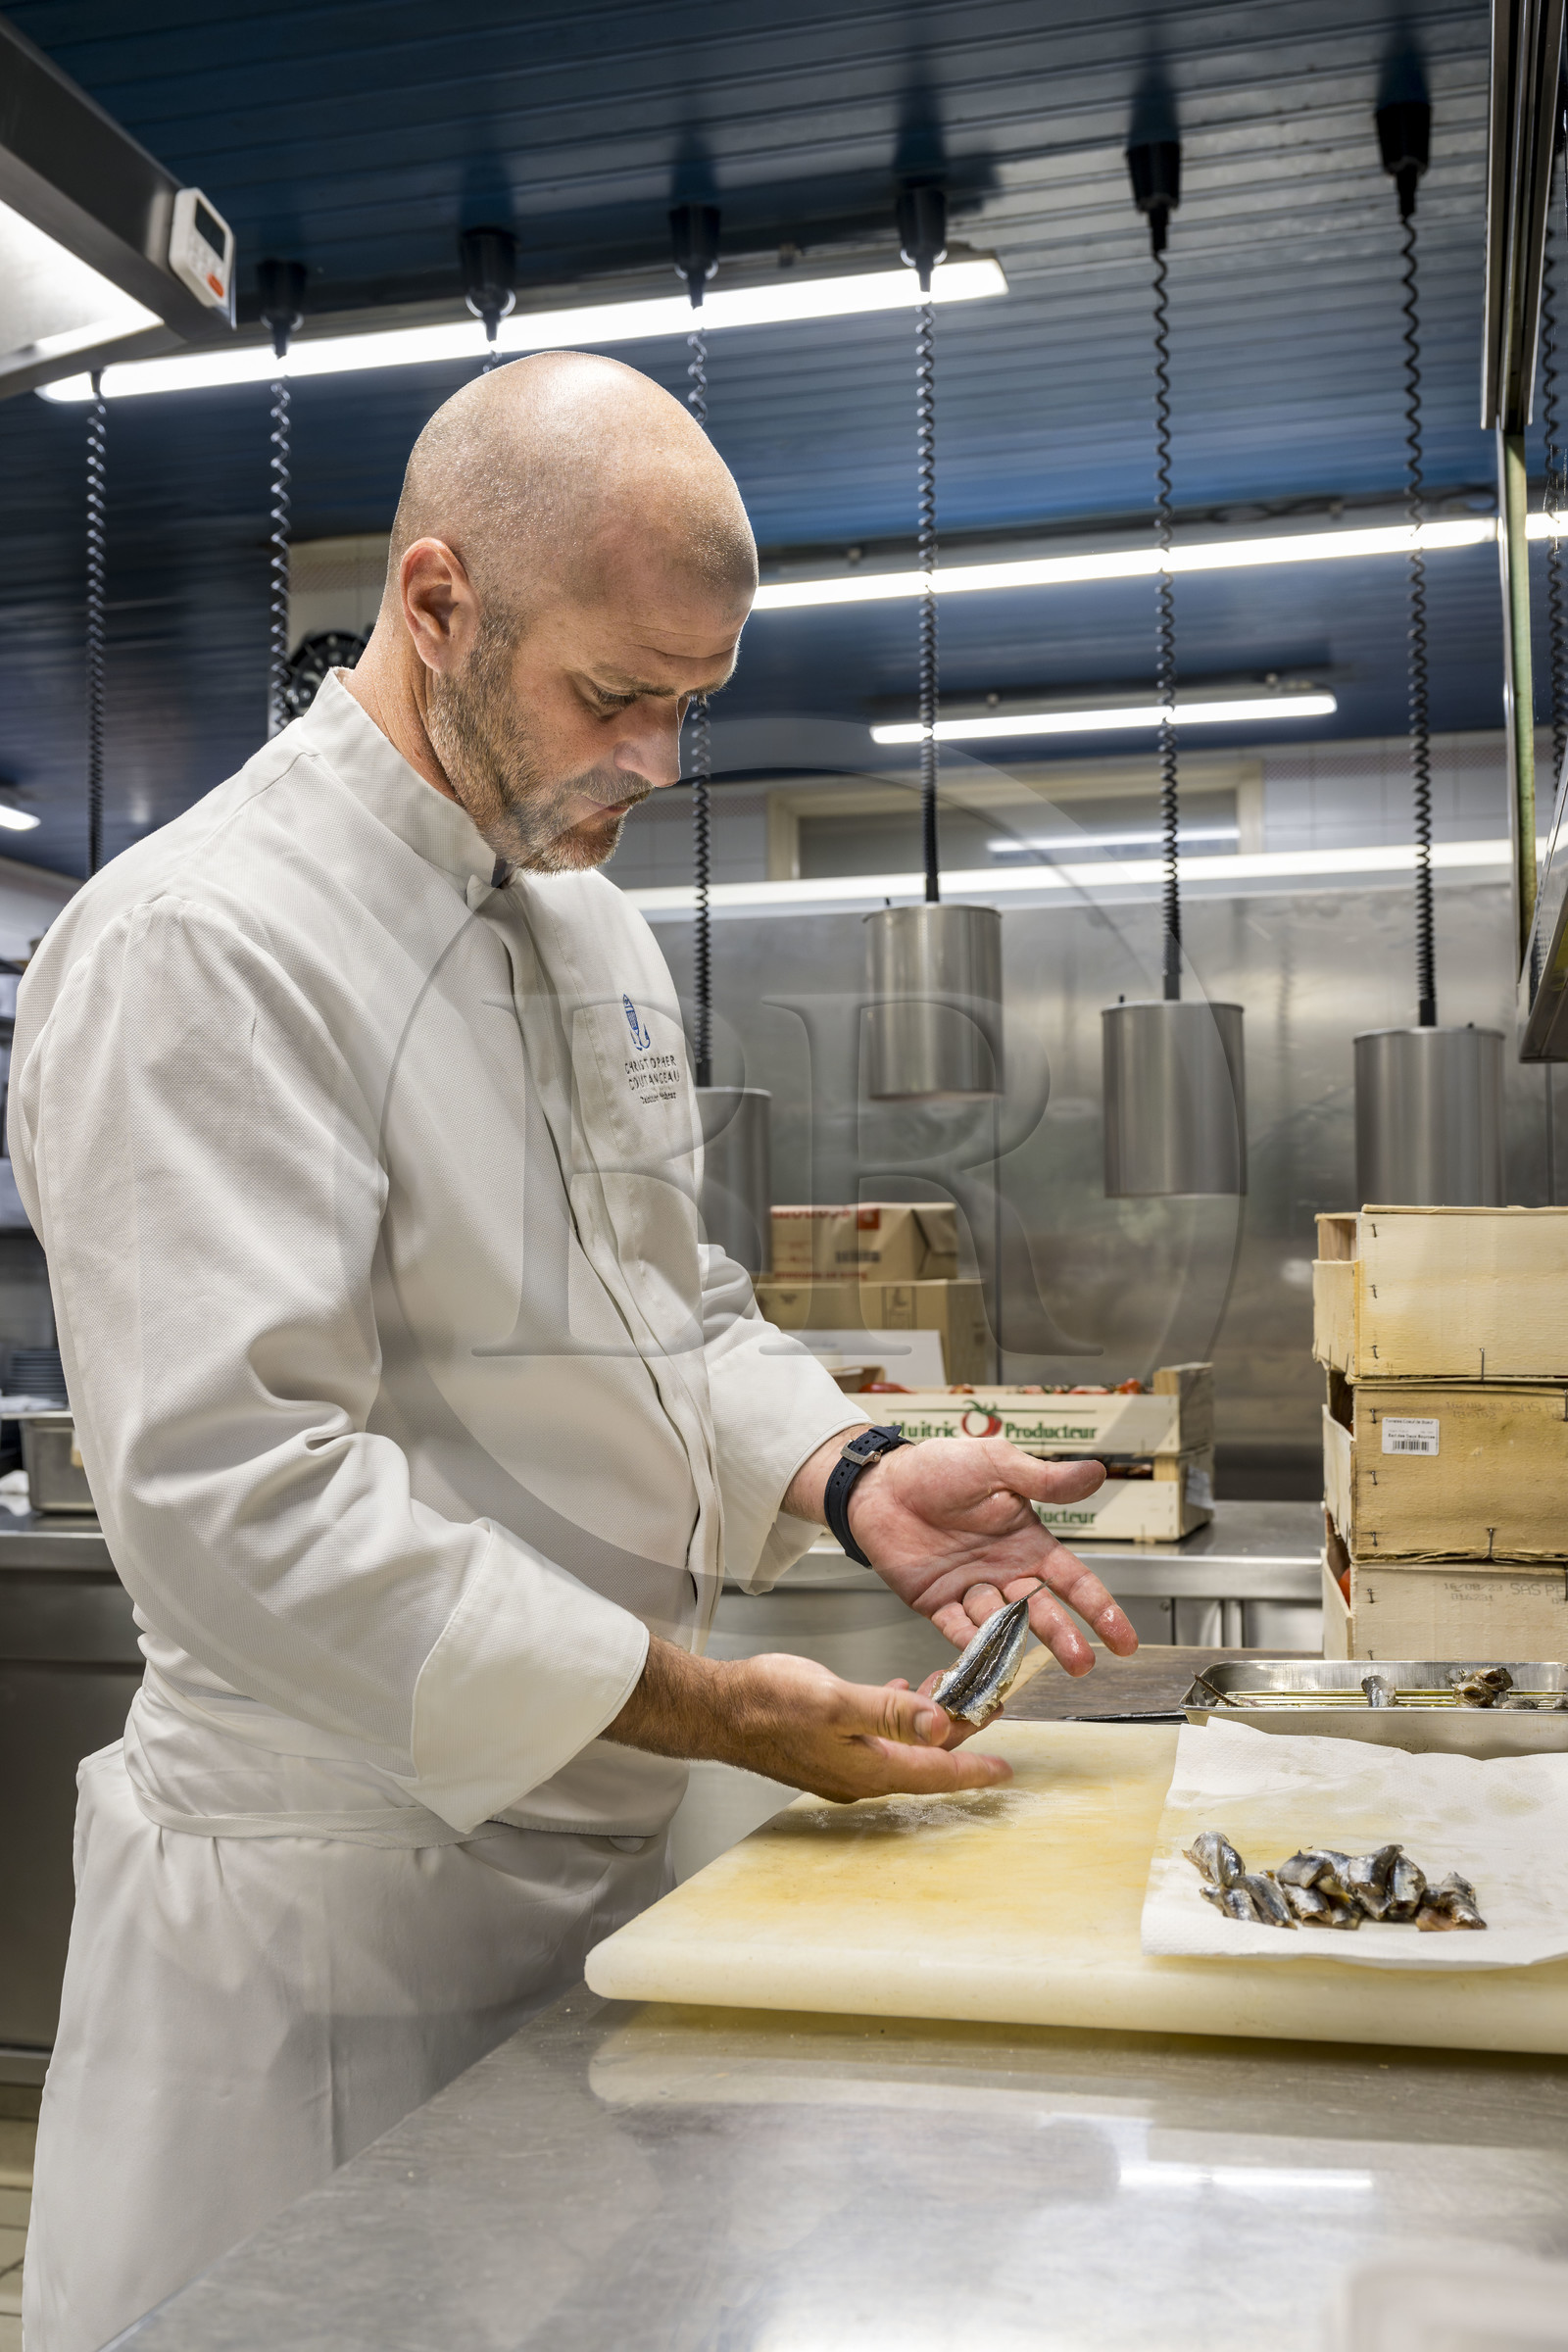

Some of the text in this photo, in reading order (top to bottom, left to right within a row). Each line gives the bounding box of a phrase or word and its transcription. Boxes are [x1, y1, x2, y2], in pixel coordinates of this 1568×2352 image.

[625, 1055, 677, 1074] CHRISTOPHER
[628, 1069, 680, 1090] COUTANCEAU
[1510, 1401, 1542, 1413] SAS
[1004, 1422, 1098, 1439] Producteur
[1510, 1583, 1542, 1595] SAS
